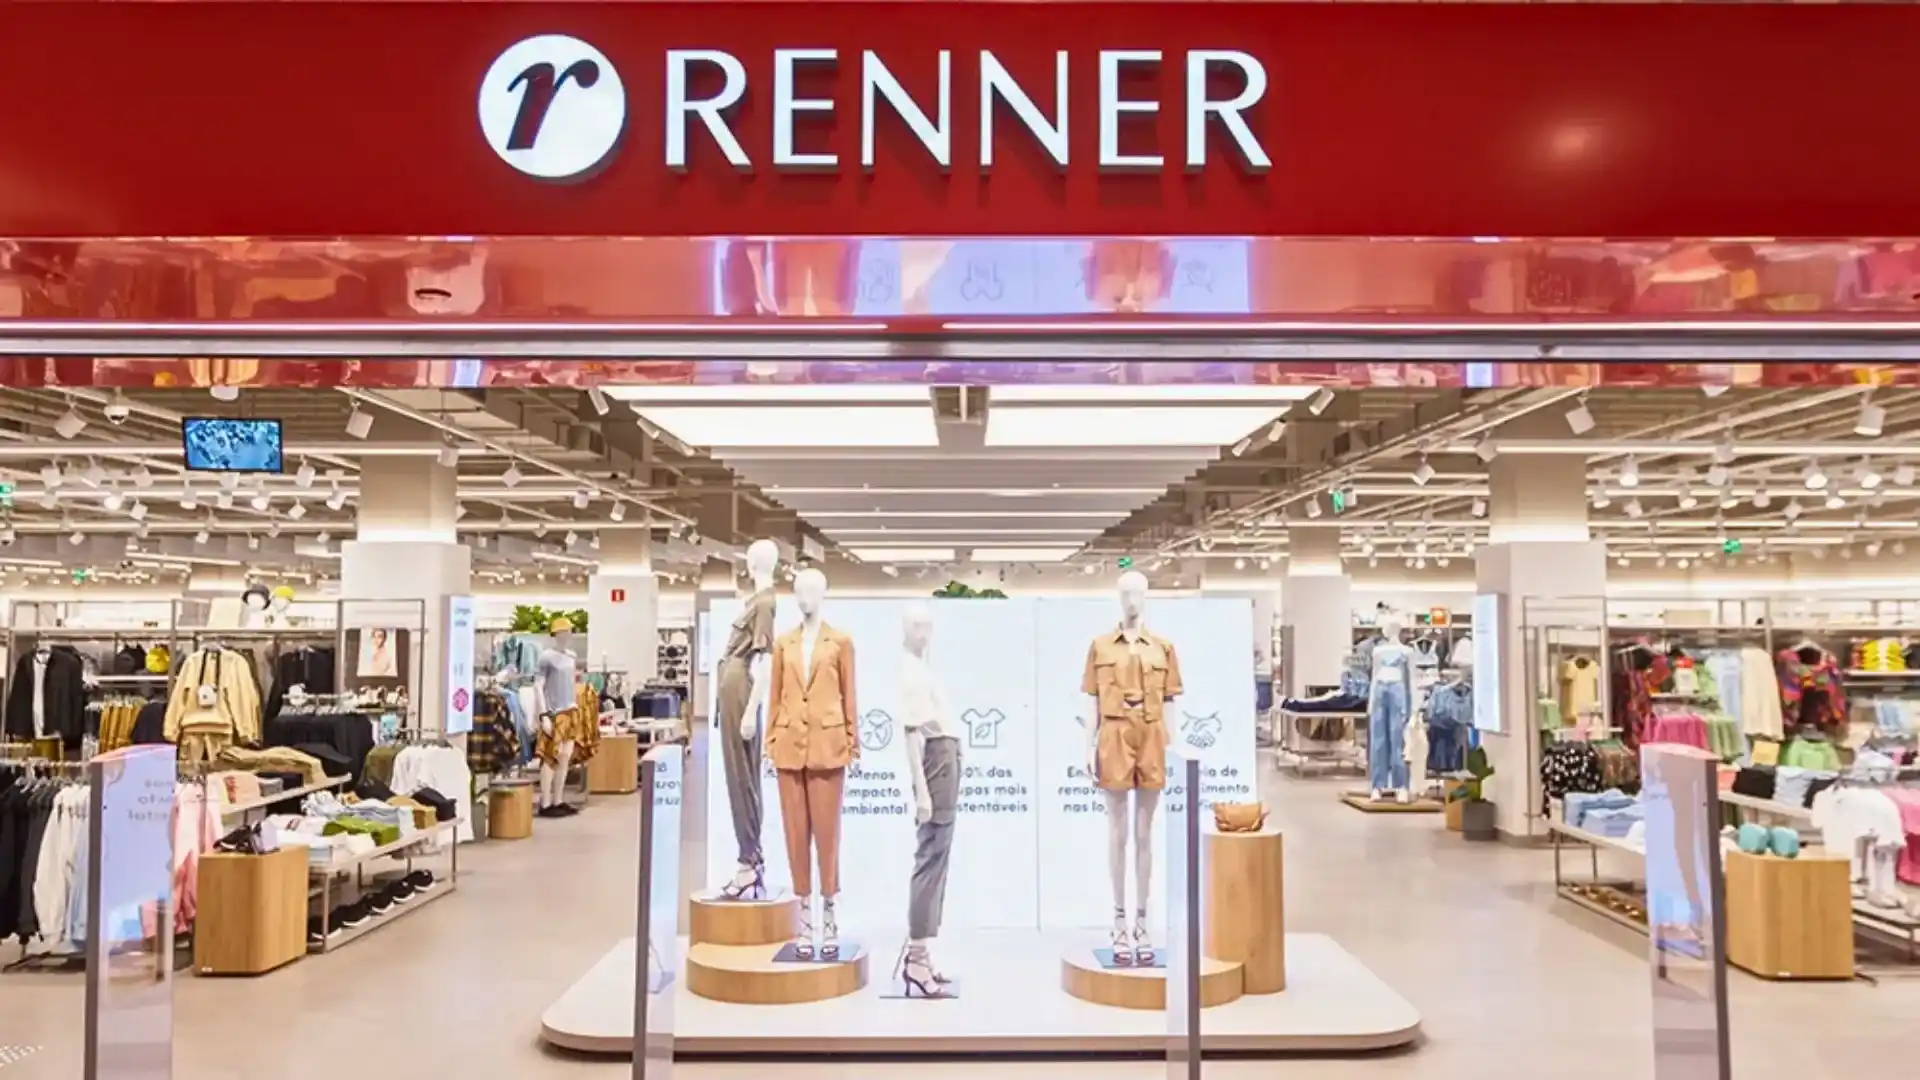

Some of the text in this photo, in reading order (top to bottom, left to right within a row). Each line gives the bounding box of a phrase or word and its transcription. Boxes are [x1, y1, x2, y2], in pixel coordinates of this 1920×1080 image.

[664, 48, 1274, 170] RENNER
[986, 766, 1012, 778] das
[994, 782, 1027, 795] mais
[1063, 803, 1088, 813] nas
